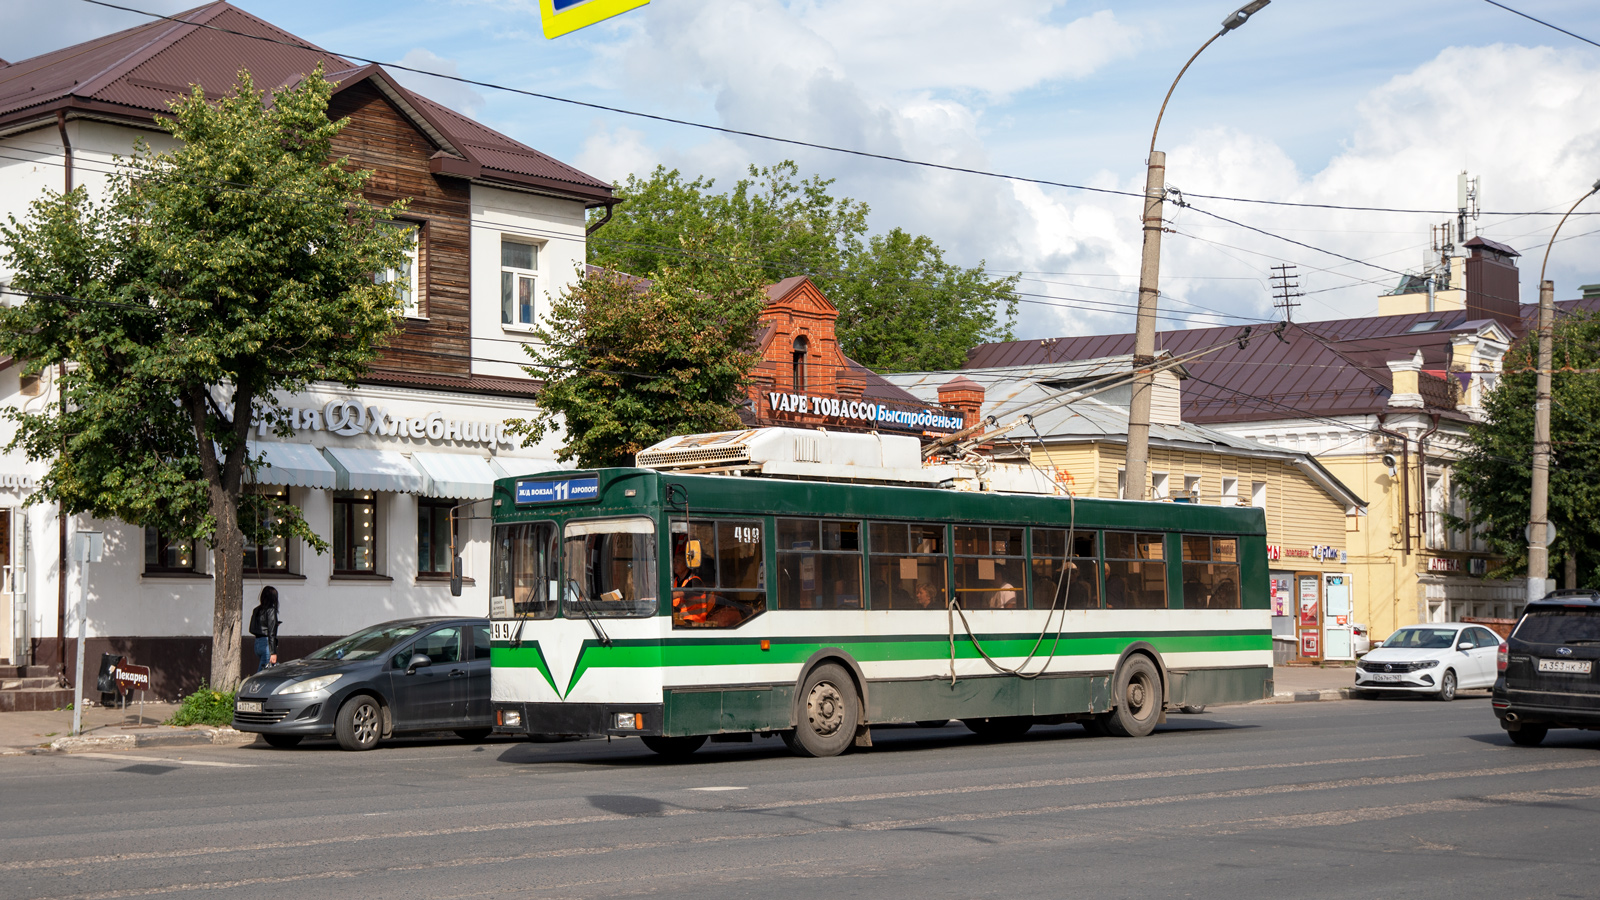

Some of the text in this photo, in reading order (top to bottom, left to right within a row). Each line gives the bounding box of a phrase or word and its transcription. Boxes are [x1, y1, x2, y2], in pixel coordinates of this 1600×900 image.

[769, 392, 876, 421] VAPE TOBACCO
[876, 405, 964, 430] Быстроденьги
[531, 488, 554, 496] ВОКЗАЛ
[555, 482, 568, 500] 11
[571, 485, 598, 494] АЭРОПОРТ
[1432, 558, 1460, 570] АПТЕКА
[116, 668, 148, 685] Пекарня
